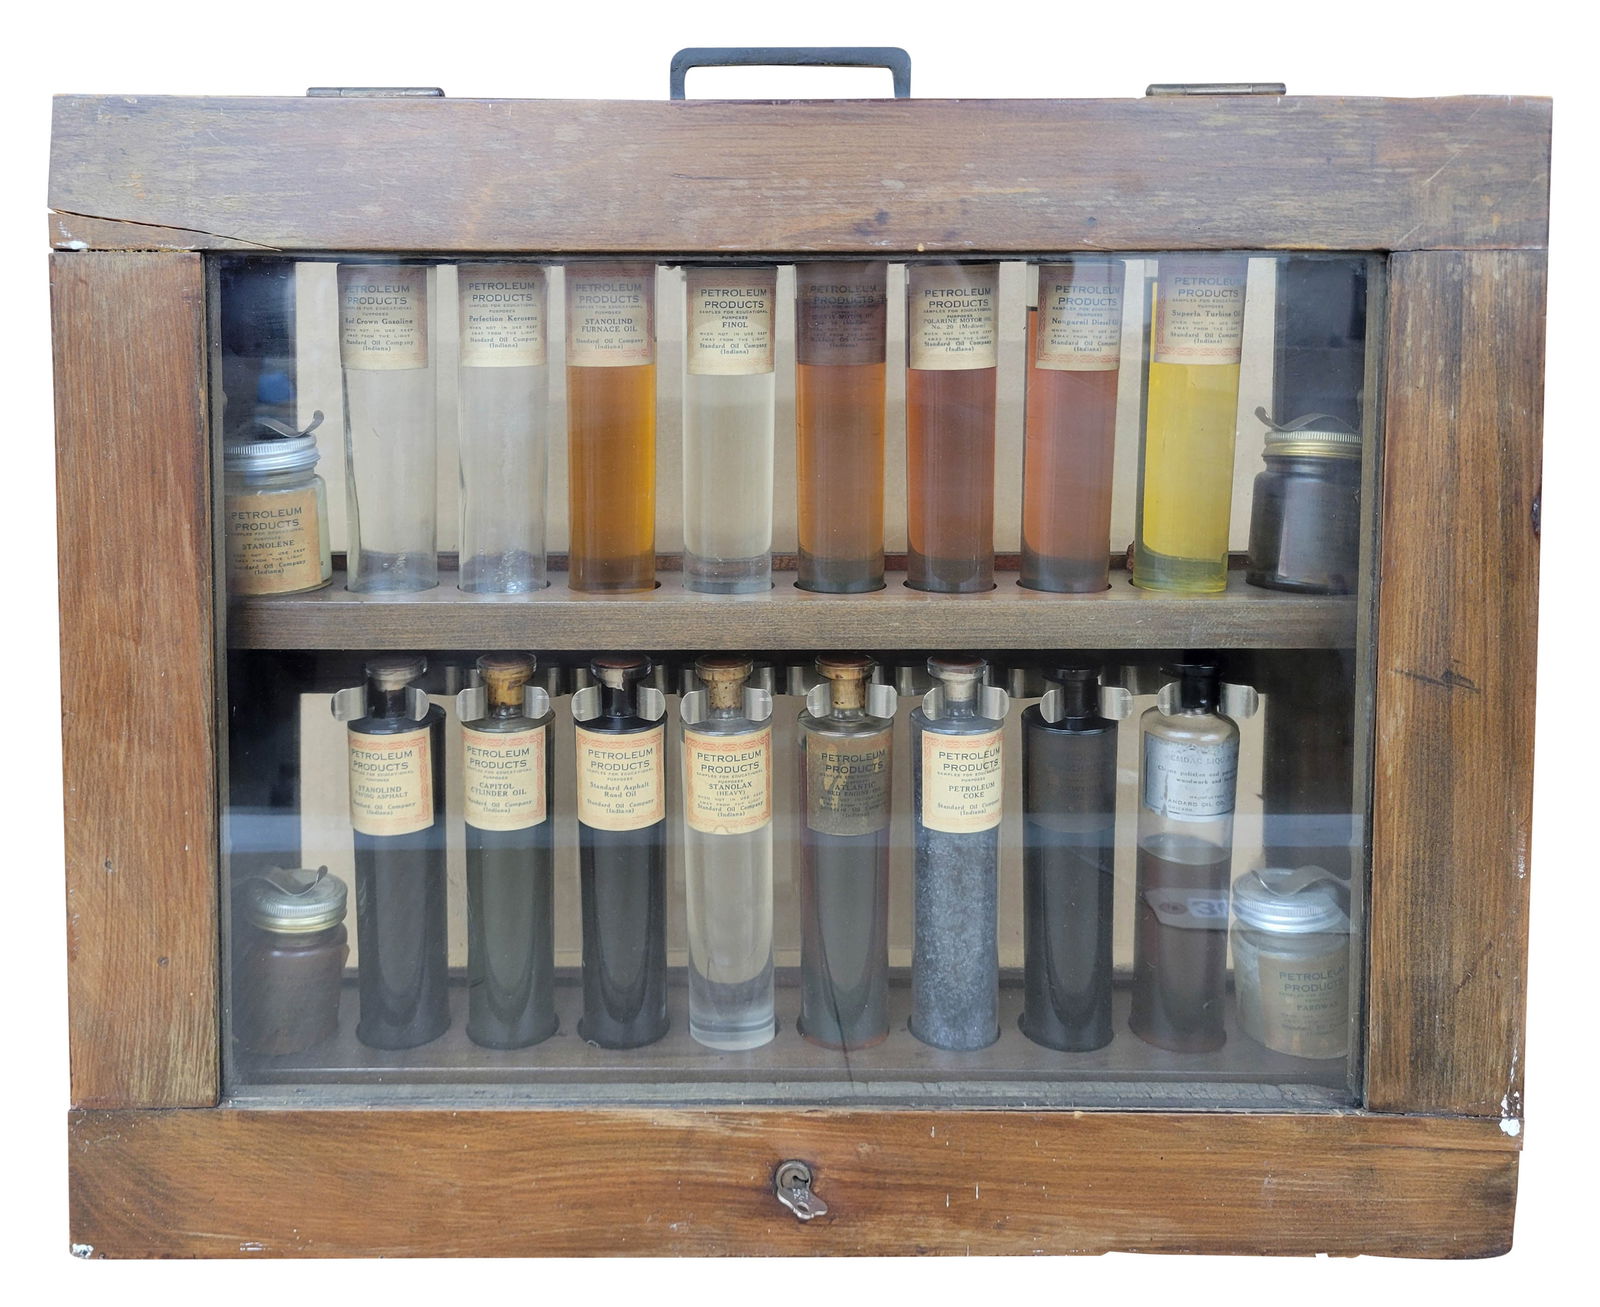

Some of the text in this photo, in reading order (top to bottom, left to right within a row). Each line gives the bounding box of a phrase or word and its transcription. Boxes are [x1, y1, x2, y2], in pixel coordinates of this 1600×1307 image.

[469, 282, 535, 290] PETROLEUM
[1175, 277, 1240, 285] PETROLEU
[344, 285, 410, 293] PETROLEUM
[576, 284, 642, 292] PETROLEUM
[701, 289, 767, 297] PETROLEUM
[925, 288, 991, 297] PETROLEUM
[1179, 289, 1238, 297] PRODUCTS
[472, 294, 532, 302] PRODUCTS
[579, 295, 640, 303] PRODUCTS
[1059, 297, 1117, 306] PRODUCTS
[929, 299, 988, 308] PRODUCTS
[232, 507, 302, 520] PETROLEUM
[236, 519, 299, 531] PRODUCTS
[242, 540, 294, 550] STANOLENE
[352, 749, 412, 760] PETROLEUM
[467, 746, 529, 758] PETROLEUM
[588, 748, 653, 759] PETROLEUM
[697, 749, 761, 762] PETROLEUM
[822, 749, 885, 762] PETROLEUM
[939, 747, 1000, 760] PETROLEUM
[354, 760, 409, 771] PRODUCTS
[470, 758, 526, 769] PRODUCTS
[591, 760, 650, 771] PRODUCTS
[701, 762, 759, 773] PRODUCTS
[826, 762, 883, 773] PRODUCTS
[944, 759, 998, 772] PRODUCTS
[590, 782, 648, 790] Standard Asphalt
[709, 781, 752, 790] STANOLAX
[949, 781, 995, 792] PETROLEUM
[471, 787, 508, 796] CYLINDER
[697, 803, 721, 811] Standard
[741, 801, 763, 810] Company
